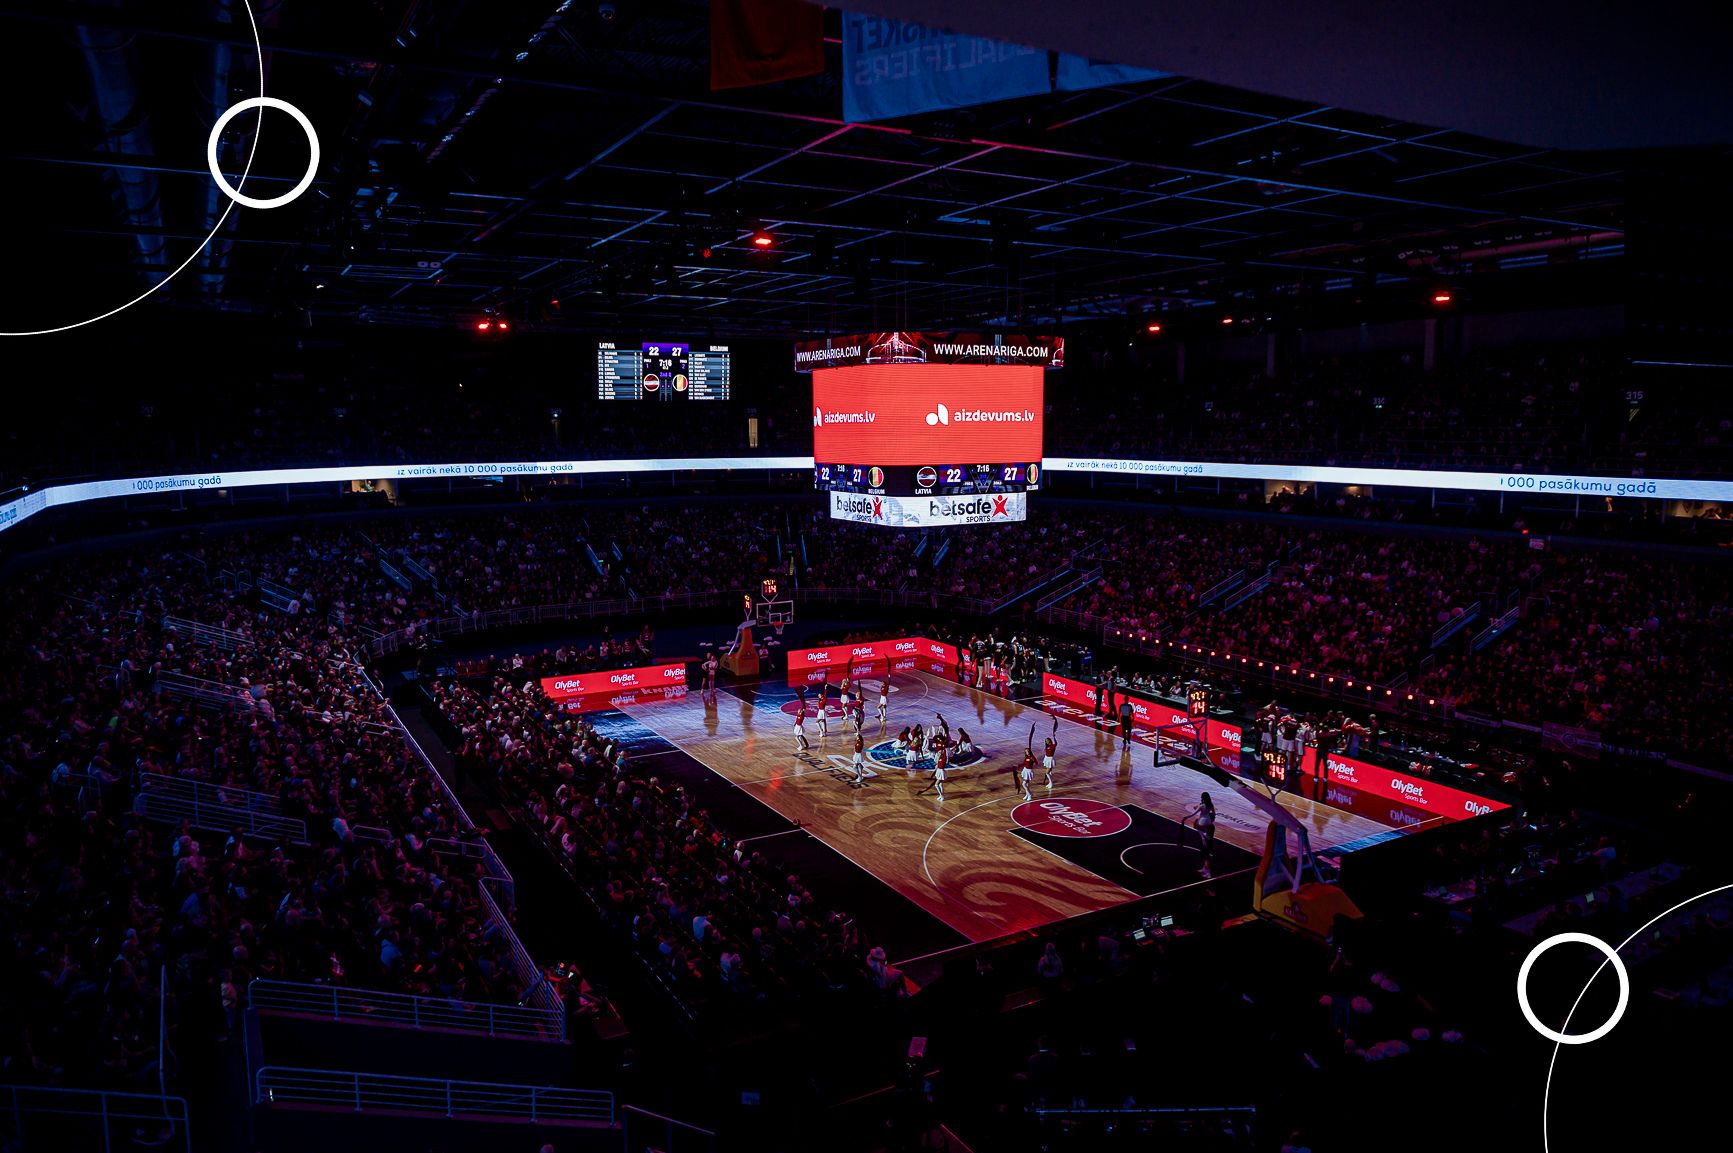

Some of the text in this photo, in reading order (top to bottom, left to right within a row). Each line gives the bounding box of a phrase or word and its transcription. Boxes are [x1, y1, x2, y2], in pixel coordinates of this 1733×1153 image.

[648, 346, 659, 356] 22
[672, 347, 682, 356] 27
[796, 346, 861, 362] WWW.ARENARIGA.COM
[934, 344, 1048, 358] WWW.ARENARIGA.COM
[824, 411, 875, 423] aizdevums.lv
[954, 409, 1034, 422] aizdevums.lv
[821, 466, 830, 480] 22
[1129, 463, 1143, 471] 000
[853, 469, 862, 482] 27
[946, 469, 961, 482] 22
[1004, 468, 1017, 481] 27
[137, 480, 153, 490] 000
[155, 478, 195, 491] pasākumu
[198, 476, 222, 489] gadā
[1507, 476, 1534, 488] 000
[1539, 479, 1611, 491] pasākumu
[1617, 482, 1657, 495] gadā
[837, 496, 872, 514] betsafe
[930, 498, 991, 516] betsafe
[966, 515, 990, 523] SPORTS
[555, 680, 580, 690] OlyBet
[610, 674, 635, 684] OlyBet
[1048, 679, 1066, 691] OlyBet
[1337, 772, 1350, 781] Sports
[1391, 778, 1424, 797] OlyBet
[1404, 793, 1428, 805] Sports Bar
[1040, 802, 1102, 827] OlyBet
